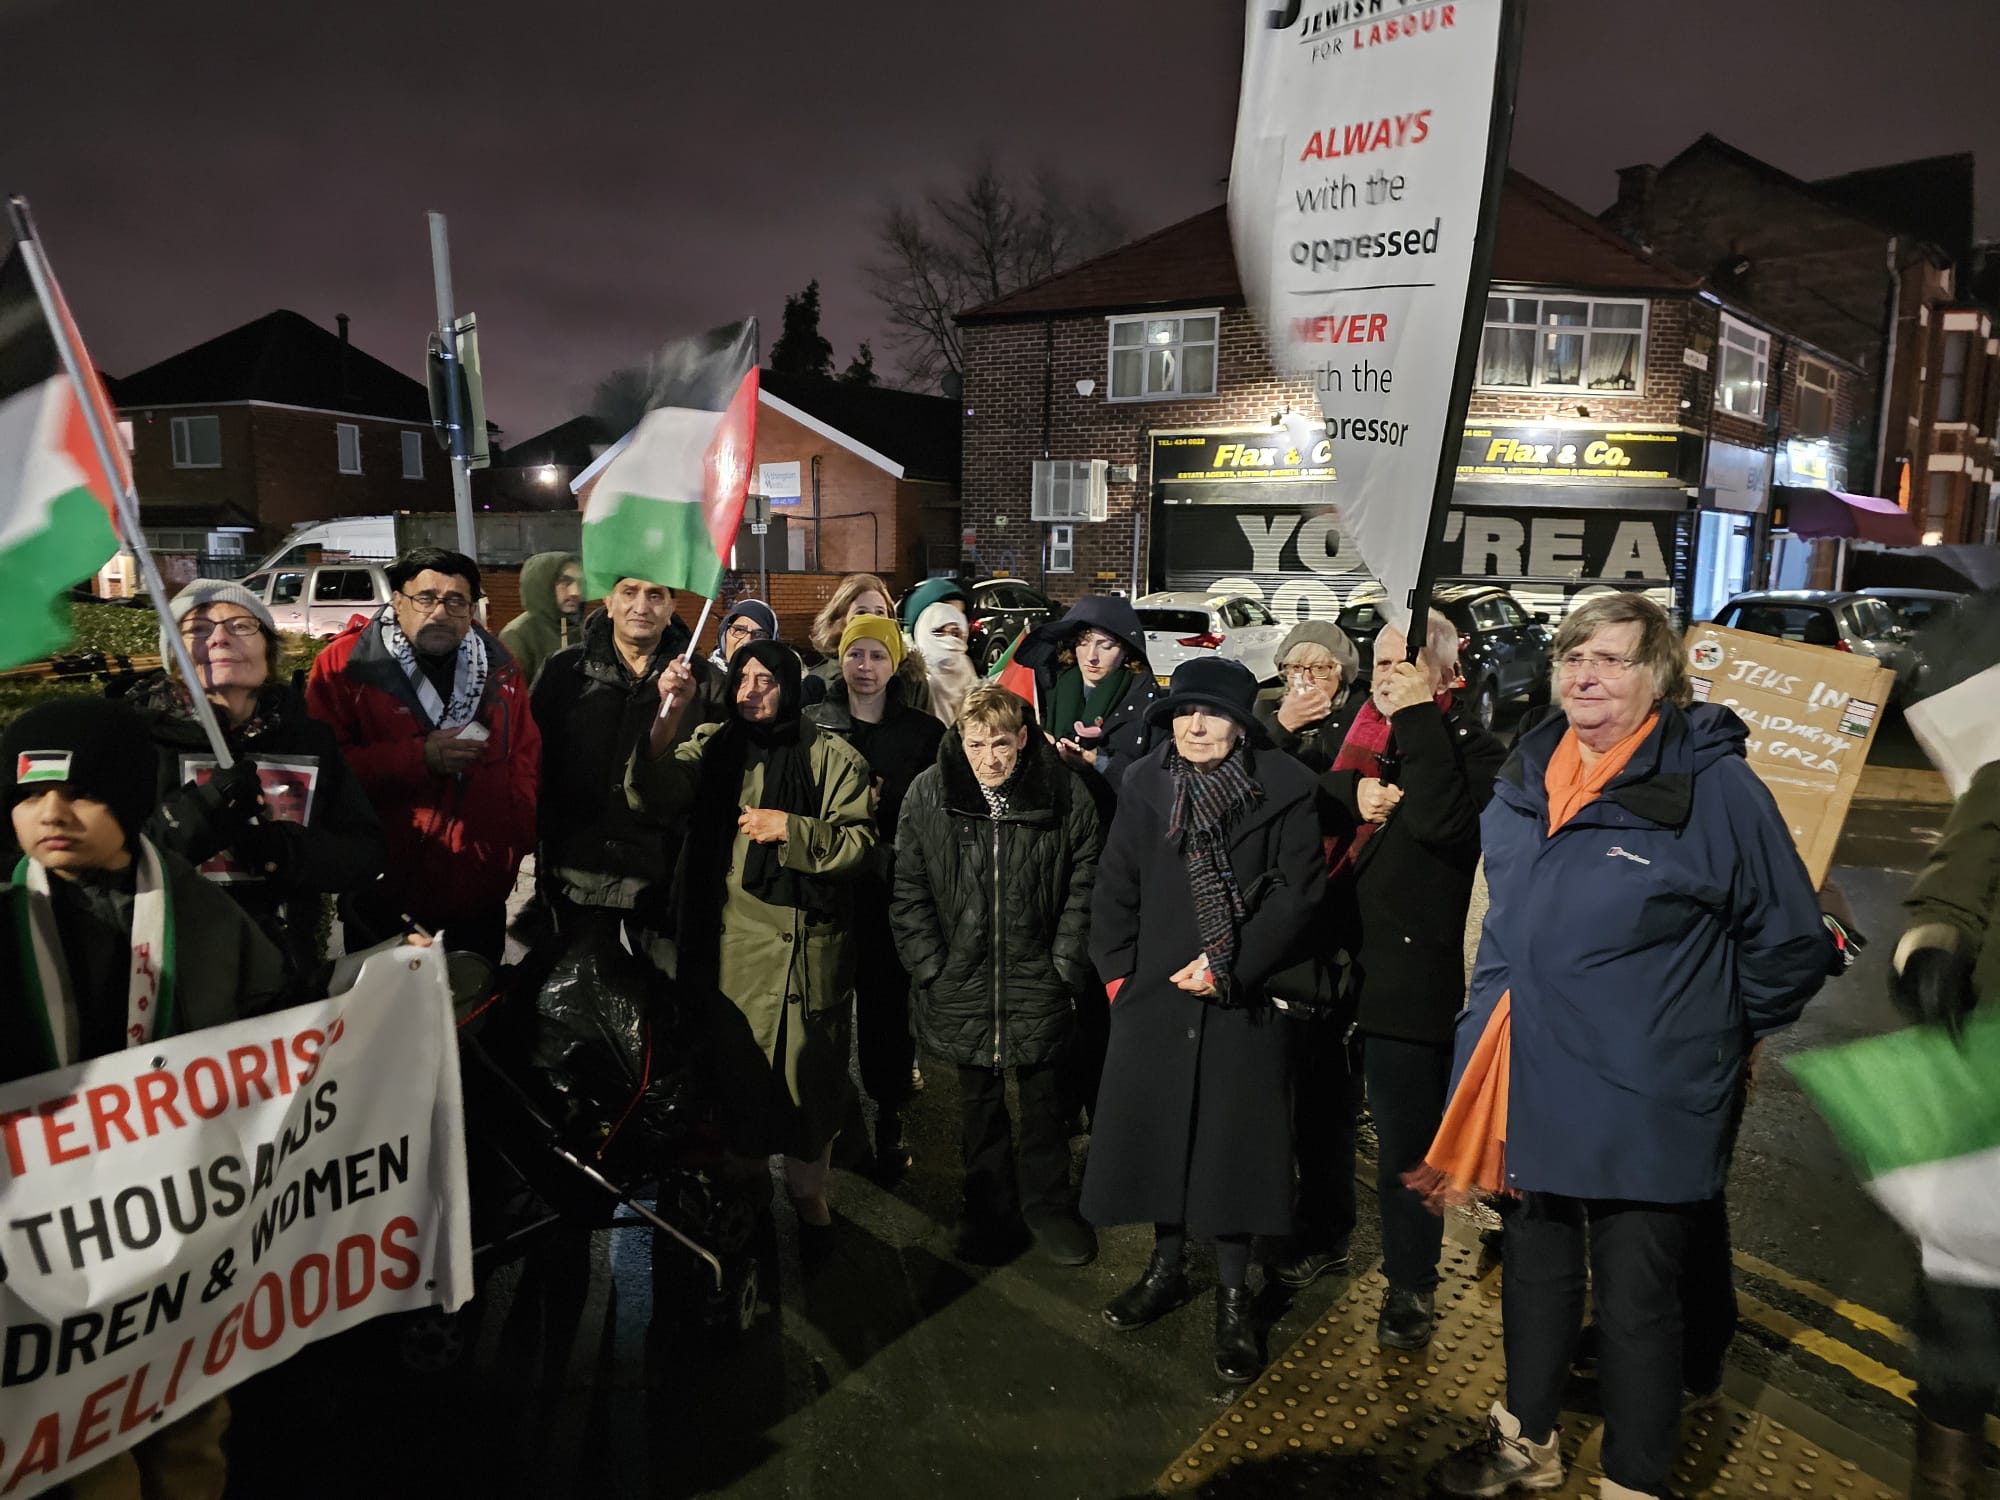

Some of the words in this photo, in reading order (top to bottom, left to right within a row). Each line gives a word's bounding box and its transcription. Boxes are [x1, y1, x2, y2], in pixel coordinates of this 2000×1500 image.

[1311, 37, 1343, 65] FOR
[1353, 4, 1456, 50] LABOUR
[1299, 109, 1433, 162] ALWAYS
[1295, 173, 1356, 213] with
[1366, 168, 1405, 205] the
[1351, 359, 1393, 393] the
[1213, 443, 1276, 468] Flax
[1283, 447, 1302, 466] &
[1485, 438, 1553, 463] Flax
[1557, 444, 1577, 465] &
[1584, 440, 1631, 466] Co.
[1600, 520, 1671, 581] A
[1728, 659, 1803, 696] JEWS
[1807, 681, 1850, 713] IN
[1768, 741, 1840, 775] GAZA
[202, 1247, 238, 1304] &
[251, 1135, 409, 1266] WOMEN
[0, 1337, 195, 1496] AELI
[202, 1215, 422, 1378] GOODS
